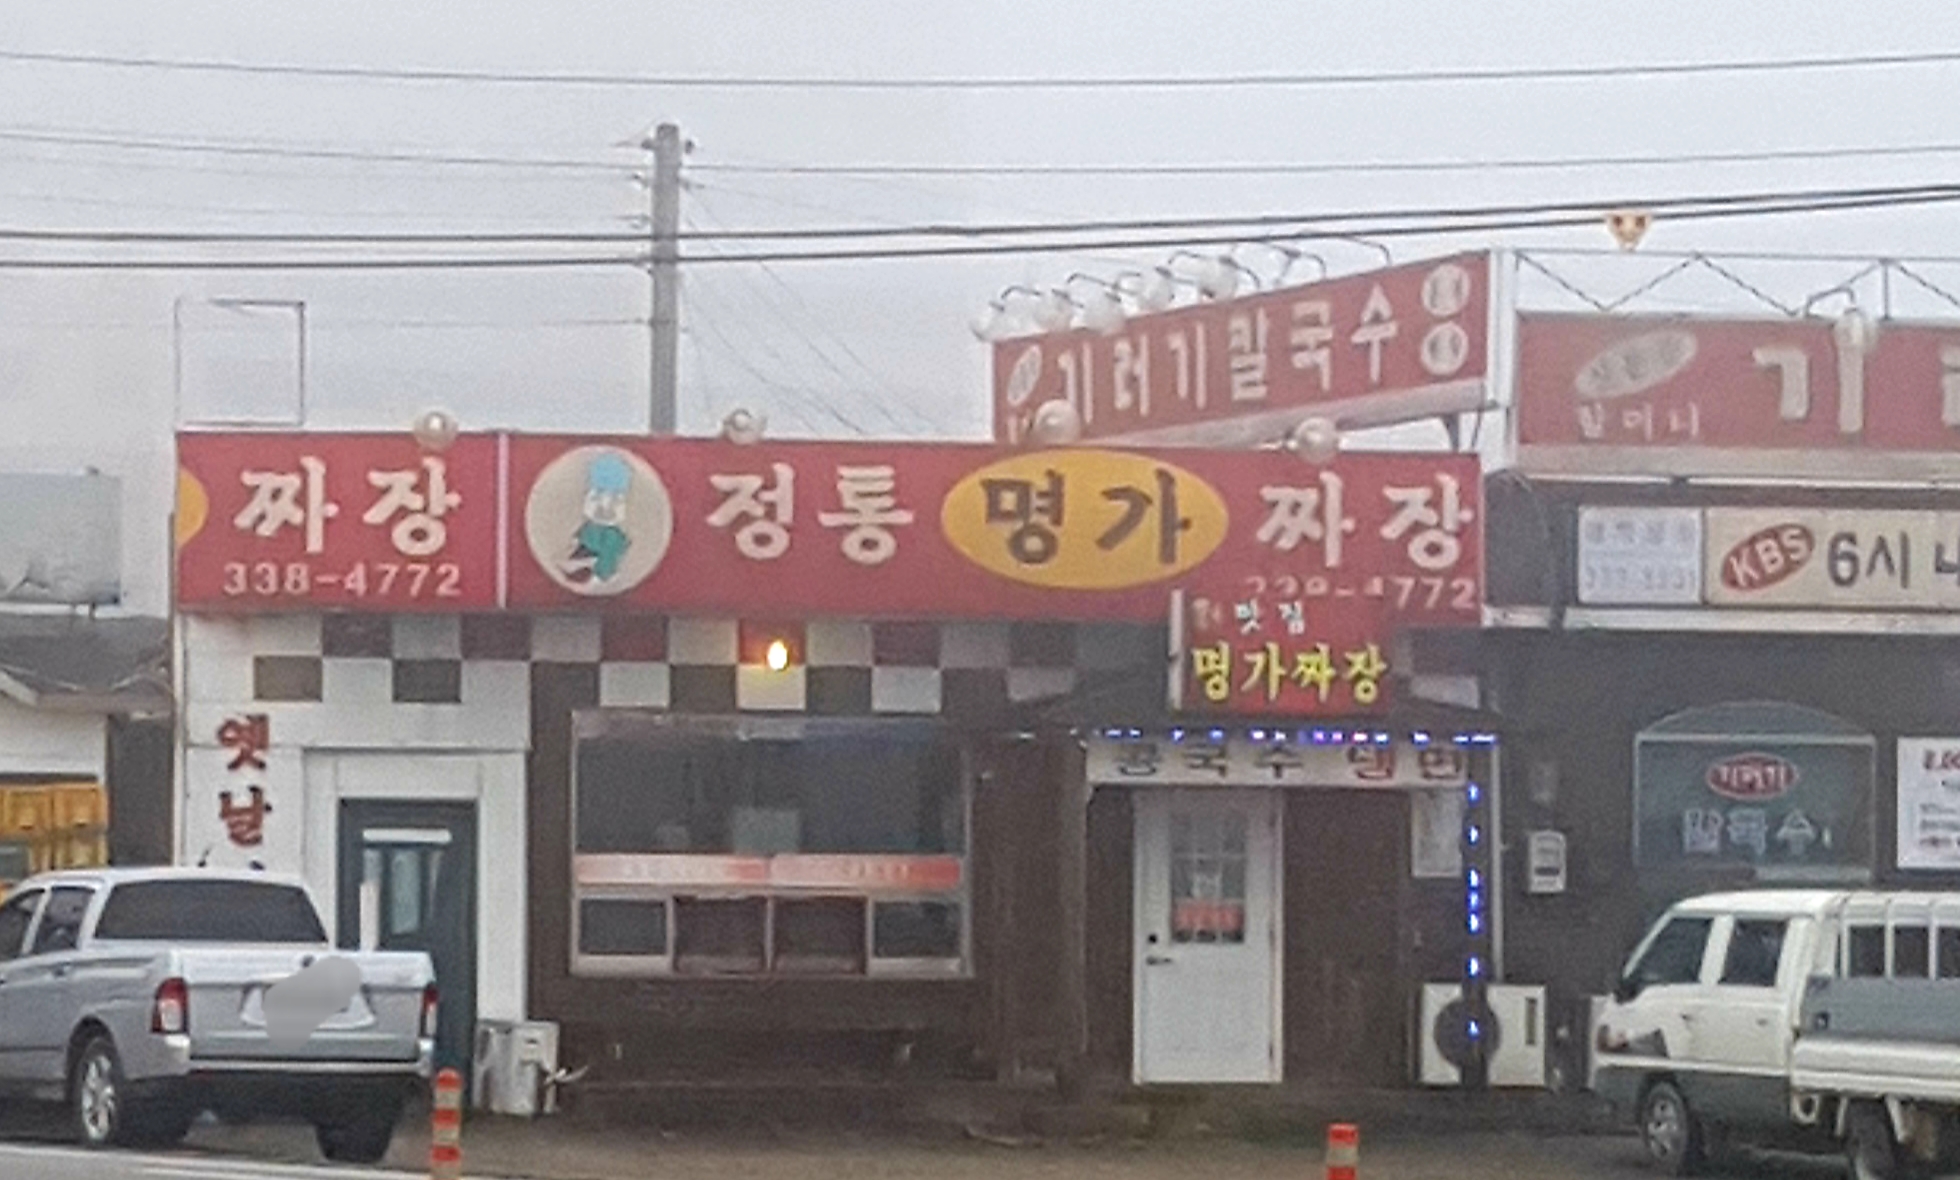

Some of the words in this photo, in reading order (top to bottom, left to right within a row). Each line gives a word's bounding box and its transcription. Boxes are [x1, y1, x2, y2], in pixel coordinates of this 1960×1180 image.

[233, 456, 462, 556] 짜장
[706, 462, 914, 565] 정통
[980, 468, 1192, 564] 명가
[1256, 471, 1475, 570] 짜장
[222, 563, 462, 598] 338-4772
[1728, 527, 1813, 588] KBS
[1827, 531, 1911, 589] 6시
